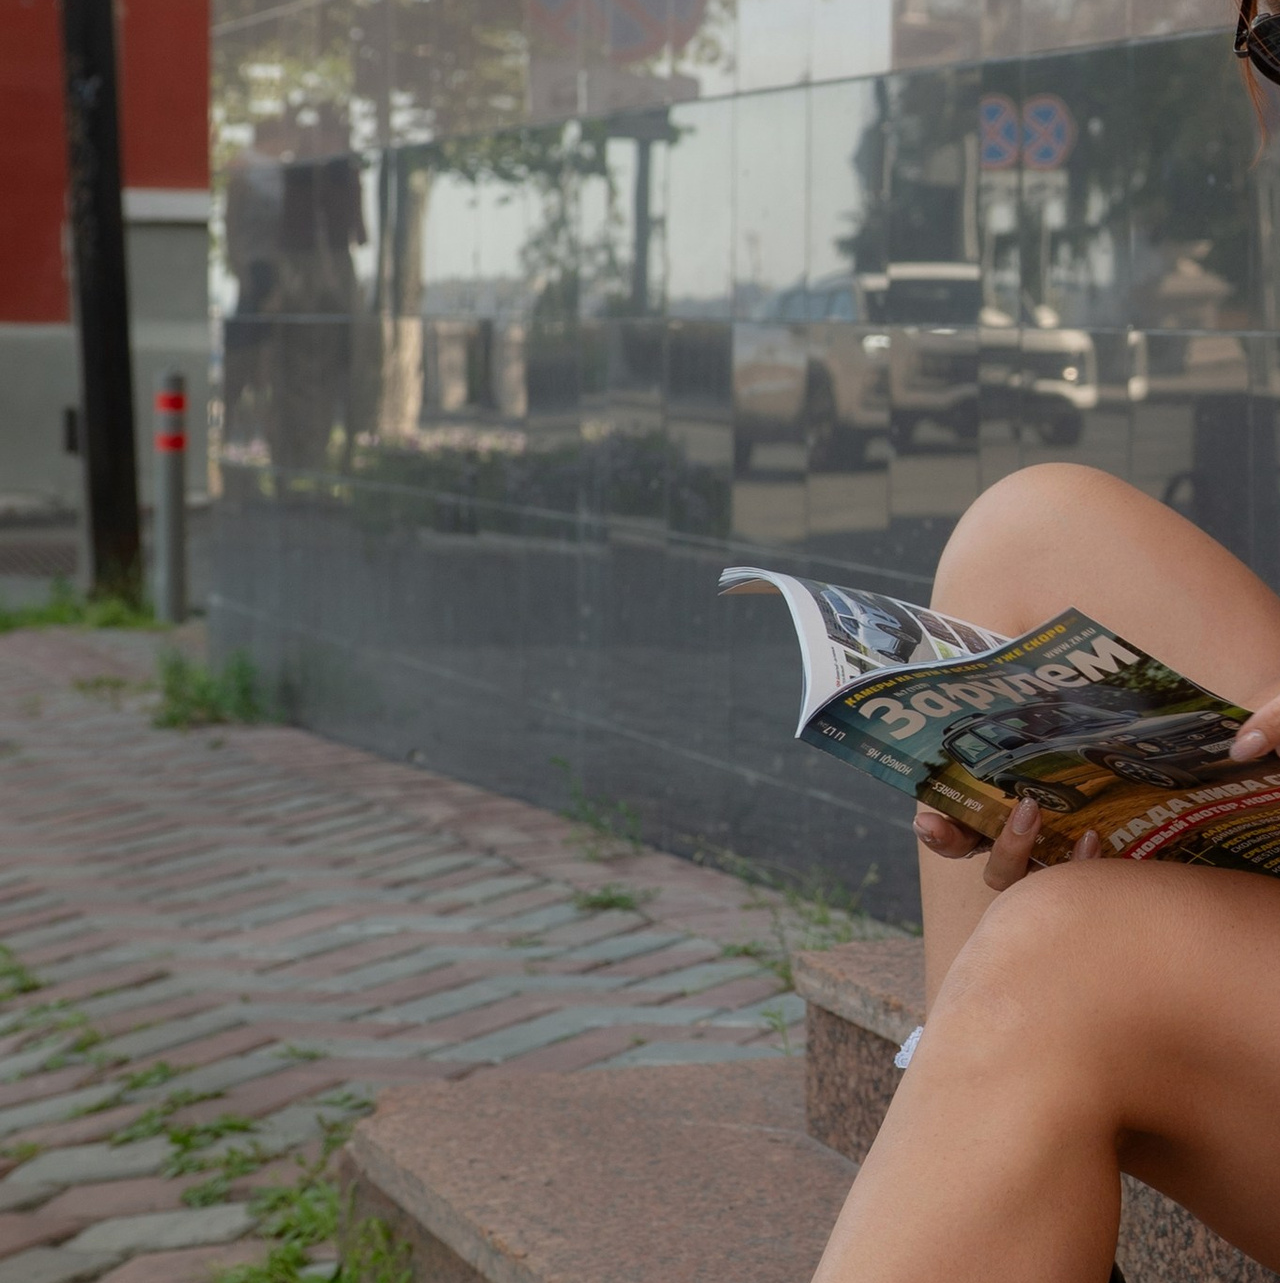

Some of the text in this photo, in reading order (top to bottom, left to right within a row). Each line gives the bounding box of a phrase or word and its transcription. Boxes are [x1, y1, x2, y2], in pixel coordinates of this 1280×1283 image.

[844, 678, 897, 707] КАМЕРЫ
[898, 674, 914, 684] НА
[995, 648, 1025, 665] УЖЕ
[1022, 624, 1067, 651] СКОРО
[866, 747, 913, 776] HONGQI H6
[932, 781, 985, 812] KGM TORRES
[1108, 798, 1194, 852] ЛАДА
[1187, 779, 1268, 806] НИВА
[1131, 818, 1190, 861] НОВЫЙ
[1231, 832, 1271, 853] СКОЛЬКО
